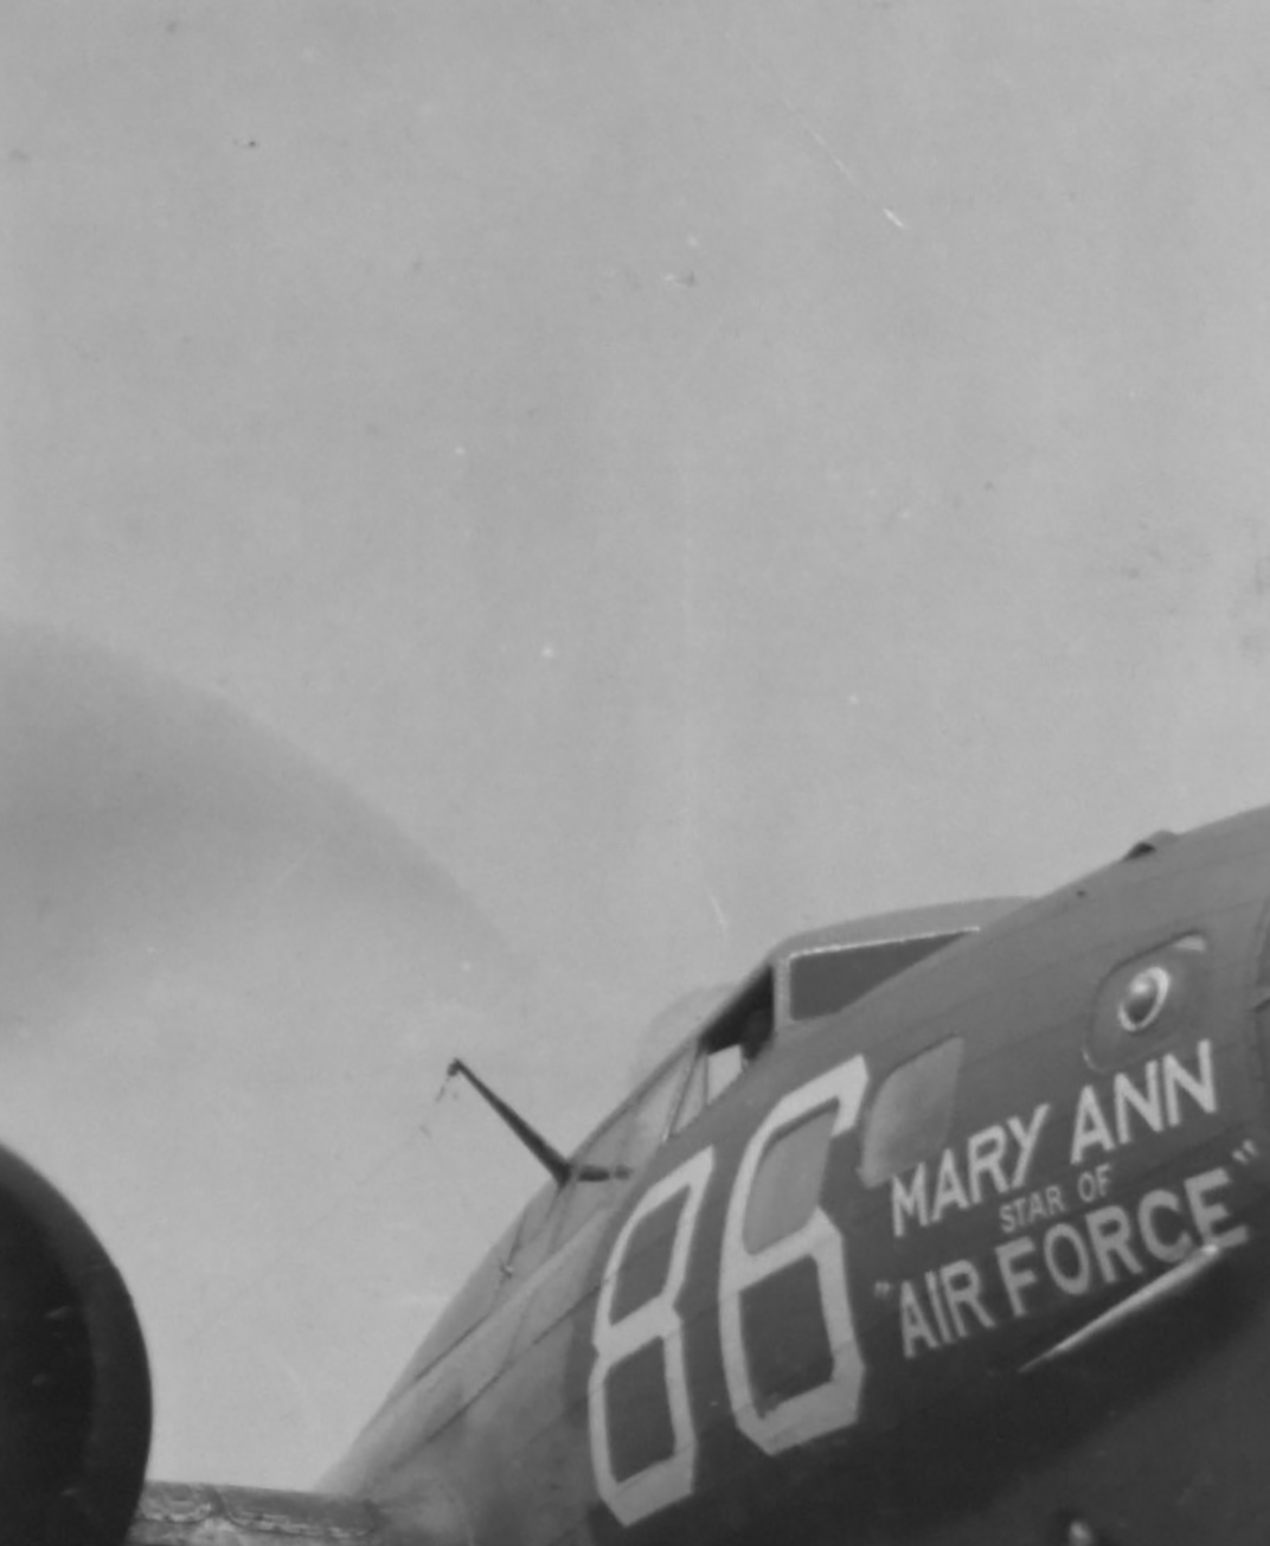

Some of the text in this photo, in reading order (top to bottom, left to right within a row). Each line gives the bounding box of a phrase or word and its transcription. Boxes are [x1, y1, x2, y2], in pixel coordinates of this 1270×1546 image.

[890, 1039, 1217, 1238] MARY ANN
[999, 1163, 1112, 1234] STAR OF
[588, 1053, 869, 1527] 86
